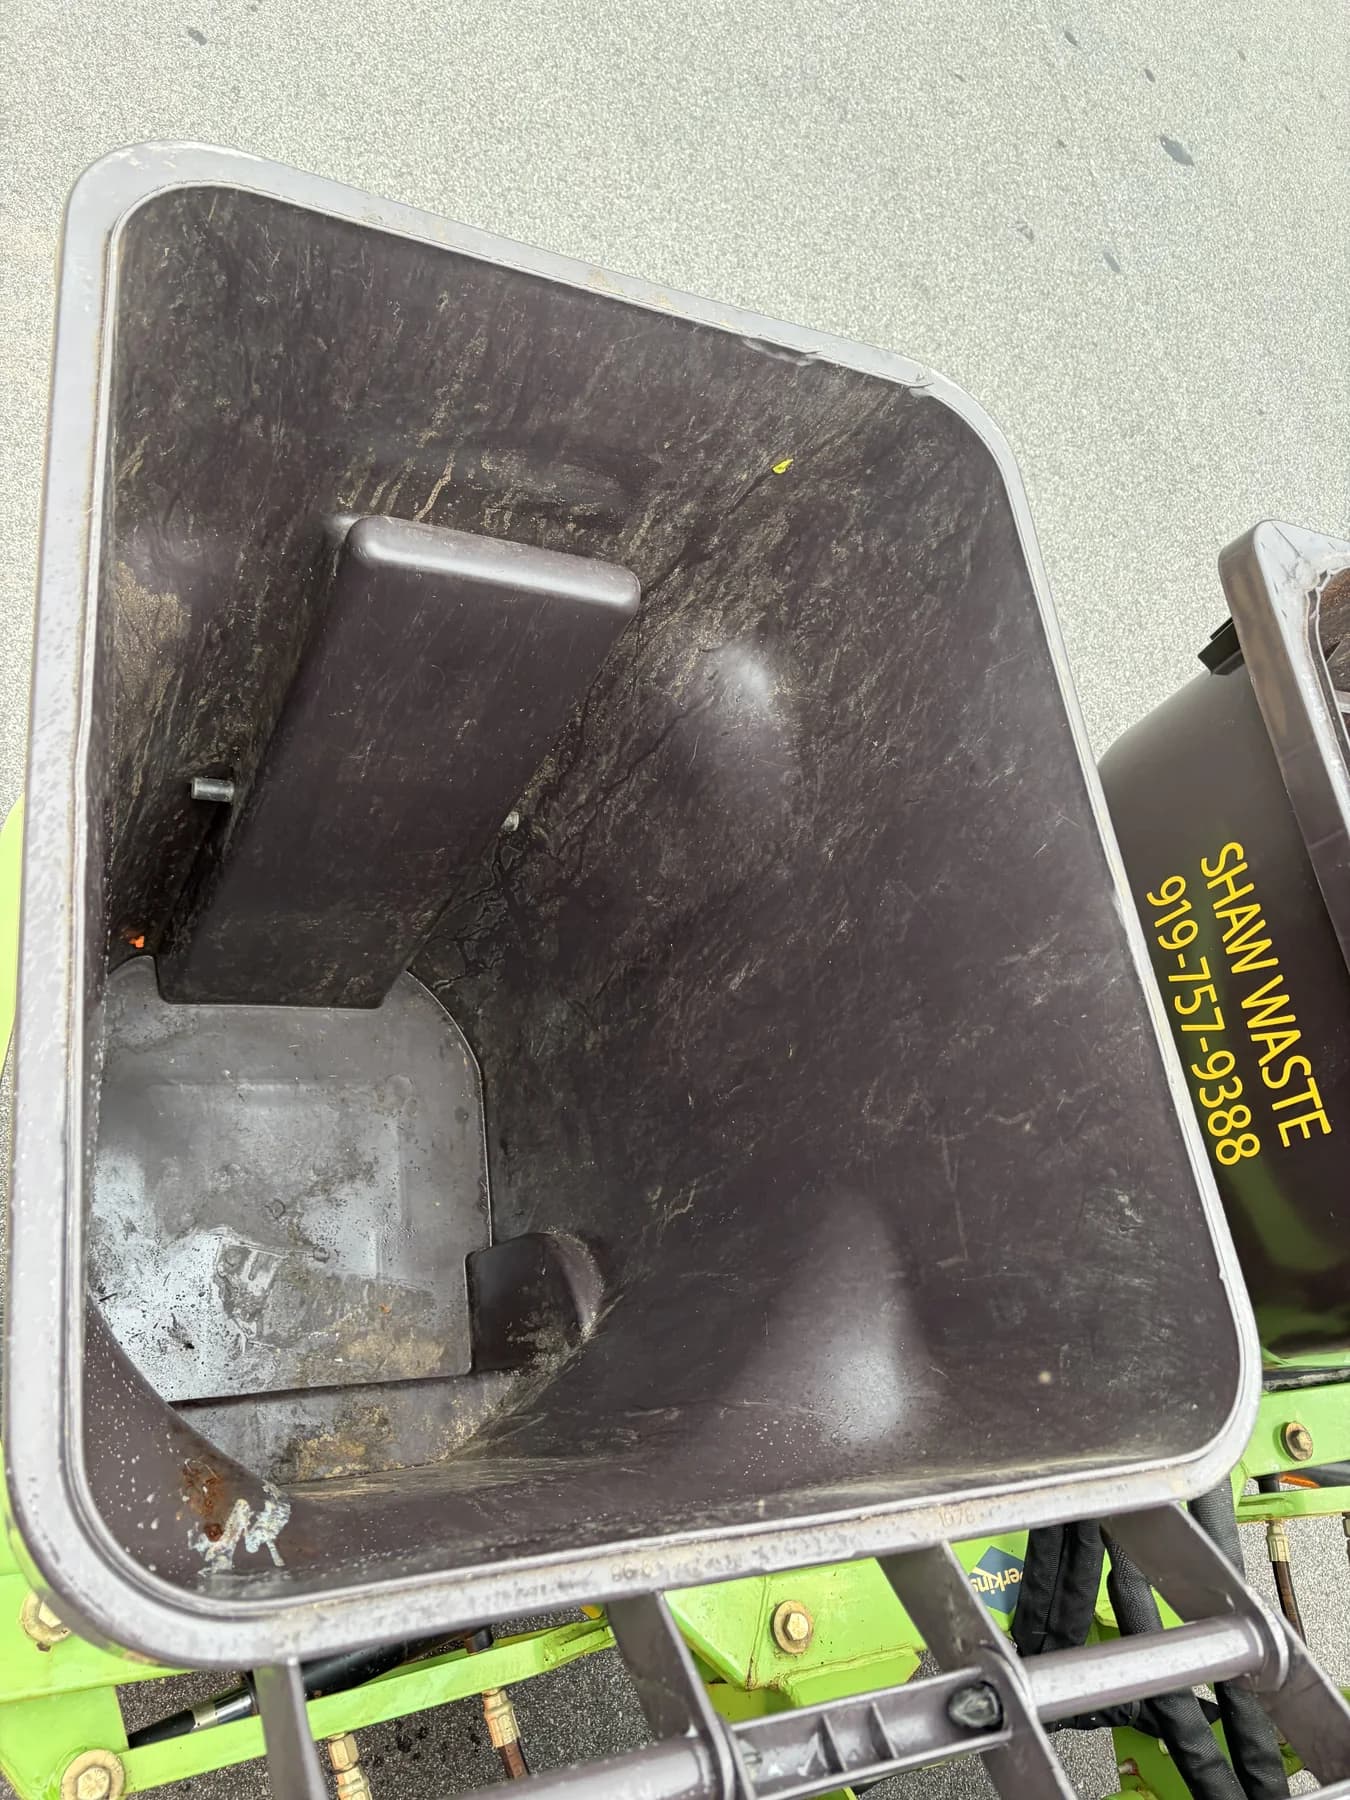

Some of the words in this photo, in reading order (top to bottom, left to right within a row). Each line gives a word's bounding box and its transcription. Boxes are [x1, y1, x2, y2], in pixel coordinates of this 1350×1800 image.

[1146, 875, 1262, 1166] 919-757-9388
[1200, 841, 1280, 974] SHAW
[1240, 974, 1333, 1148] WASTE
[969, 1567, 1023, 1595] erkins
